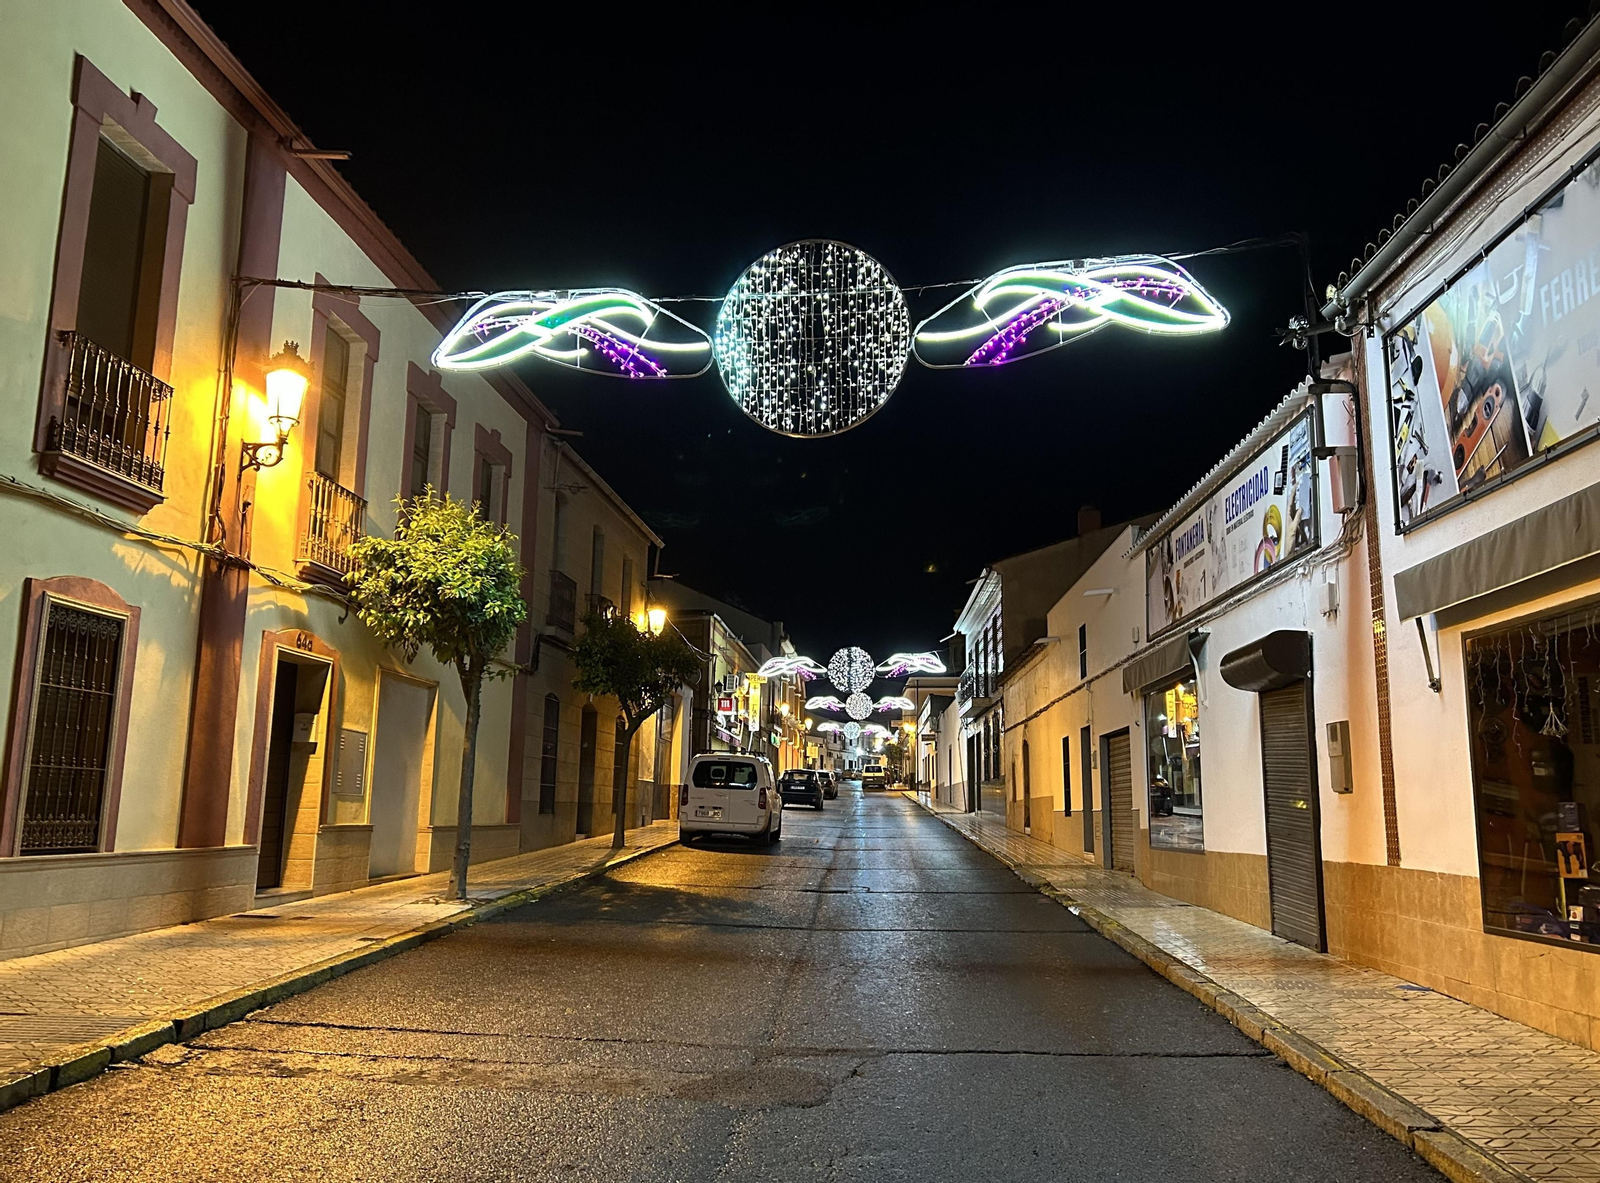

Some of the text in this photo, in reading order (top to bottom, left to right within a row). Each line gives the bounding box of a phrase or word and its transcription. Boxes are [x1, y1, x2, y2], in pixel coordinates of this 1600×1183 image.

[1540, 249, 1600, 330] FERRE
[1225, 466, 1268, 525] ELECTRICIDAD
[1175, 514, 1204, 563] FONTANERÍA
[1578, 676, 1593, 744] DESBROZADORA
